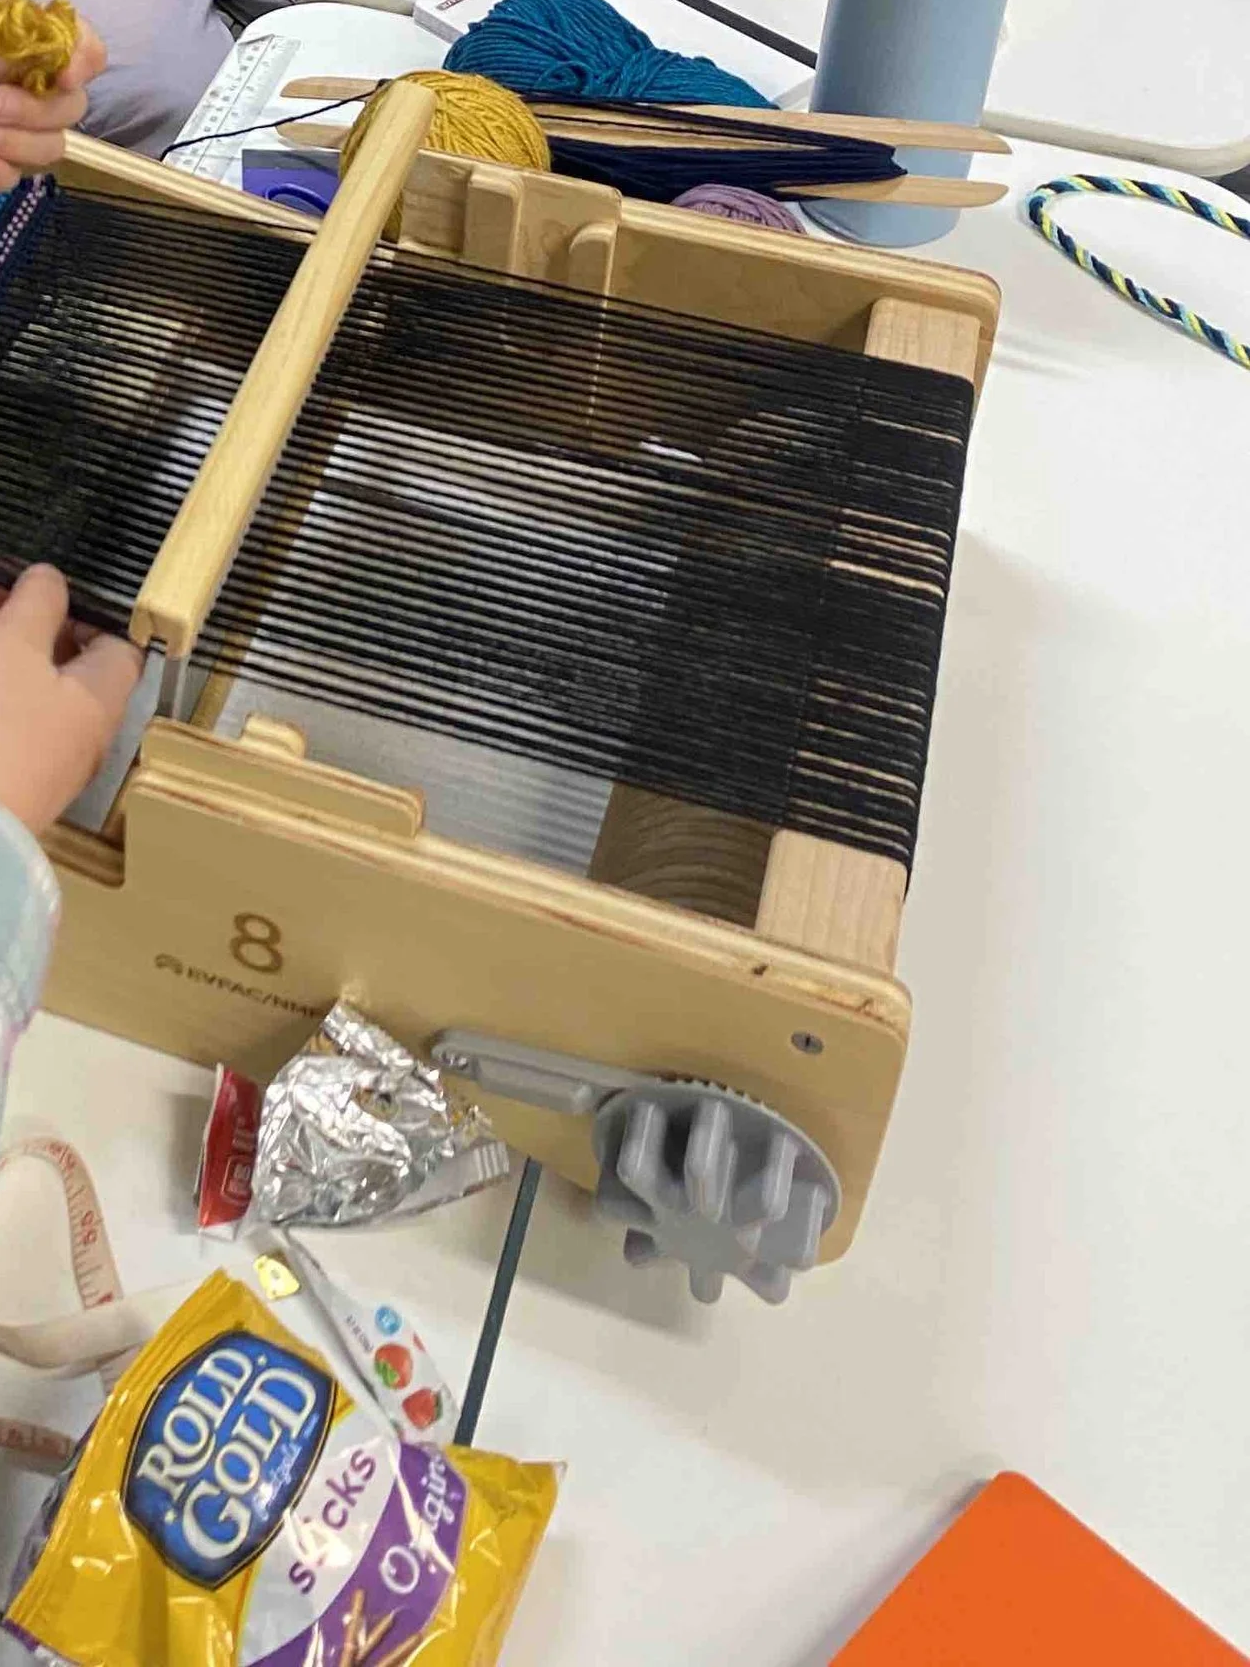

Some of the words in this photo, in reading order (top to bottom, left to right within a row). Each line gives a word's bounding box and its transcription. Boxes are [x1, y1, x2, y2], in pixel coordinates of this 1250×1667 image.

[229, 911, 284, 974] 8
[136, 1348, 253, 1503] ROLD
[182, 1367, 317, 1559] GOLD
[288, 1449, 377, 1595] scks
